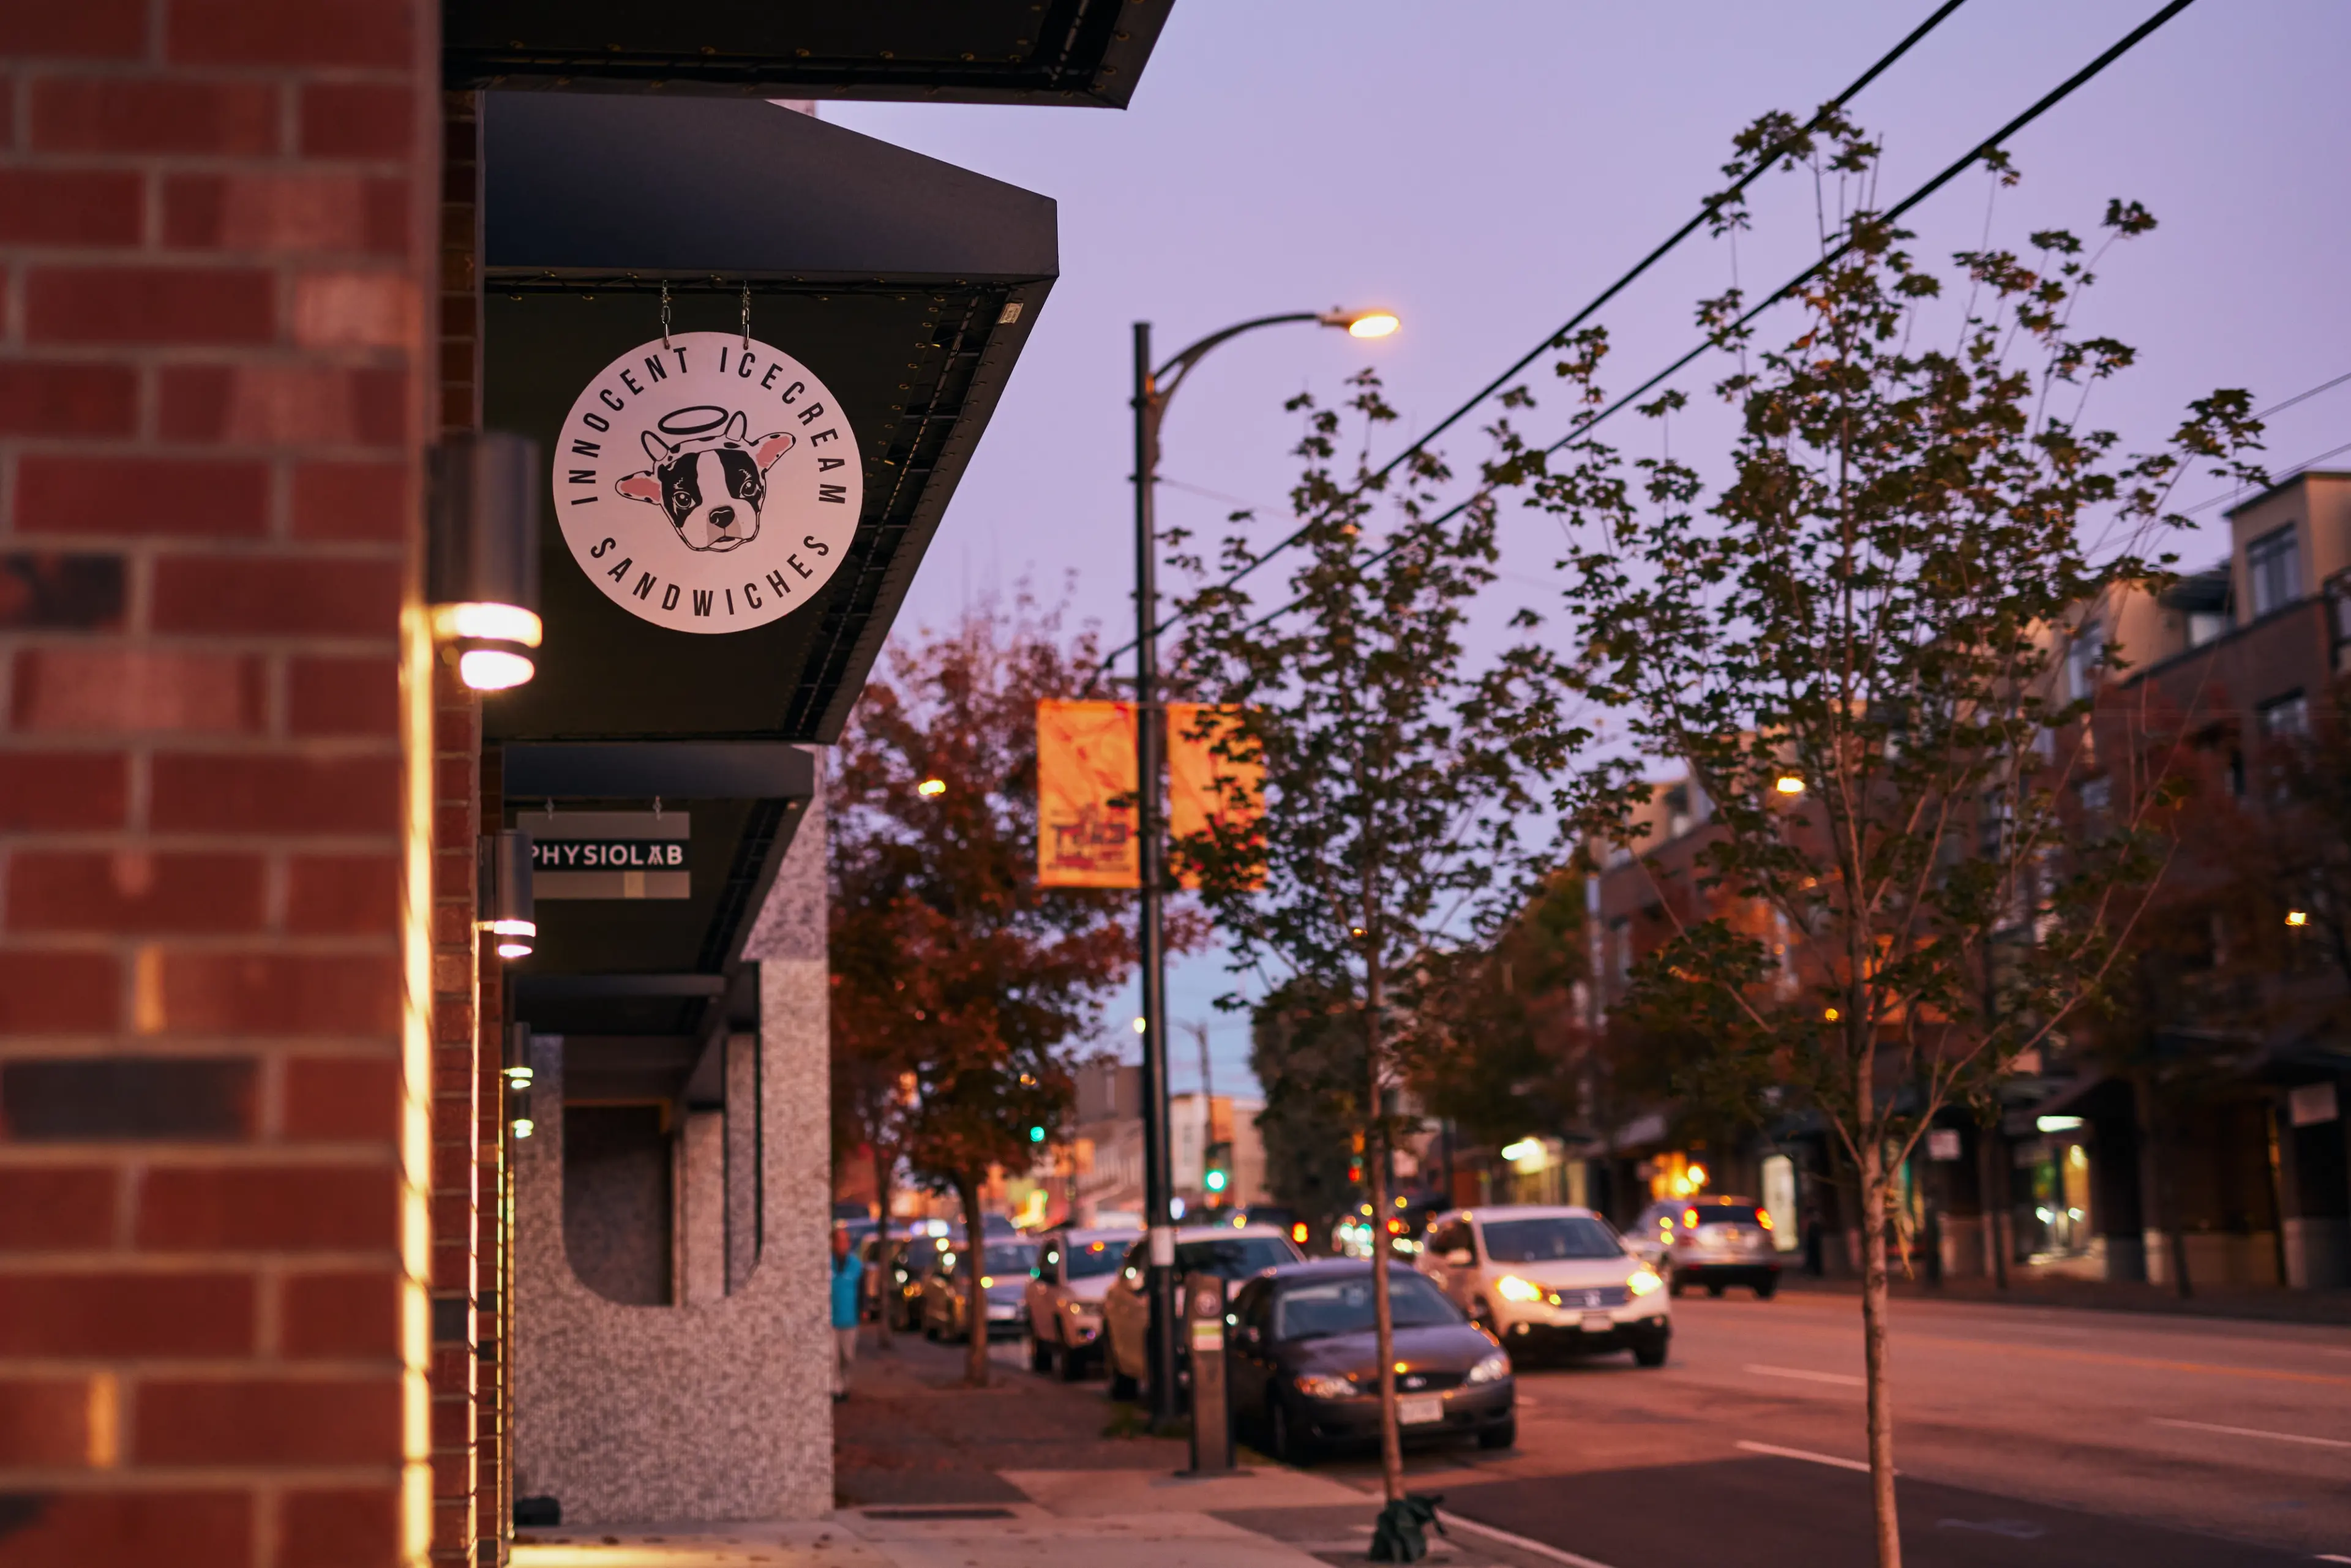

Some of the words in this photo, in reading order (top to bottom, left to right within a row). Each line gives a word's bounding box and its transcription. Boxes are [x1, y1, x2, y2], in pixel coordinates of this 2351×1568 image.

[569, 347, 688, 506] INNOCENT
[719, 347, 847, 504] ICECREAM
[590, 537, 830, 617] SANDWICHES
